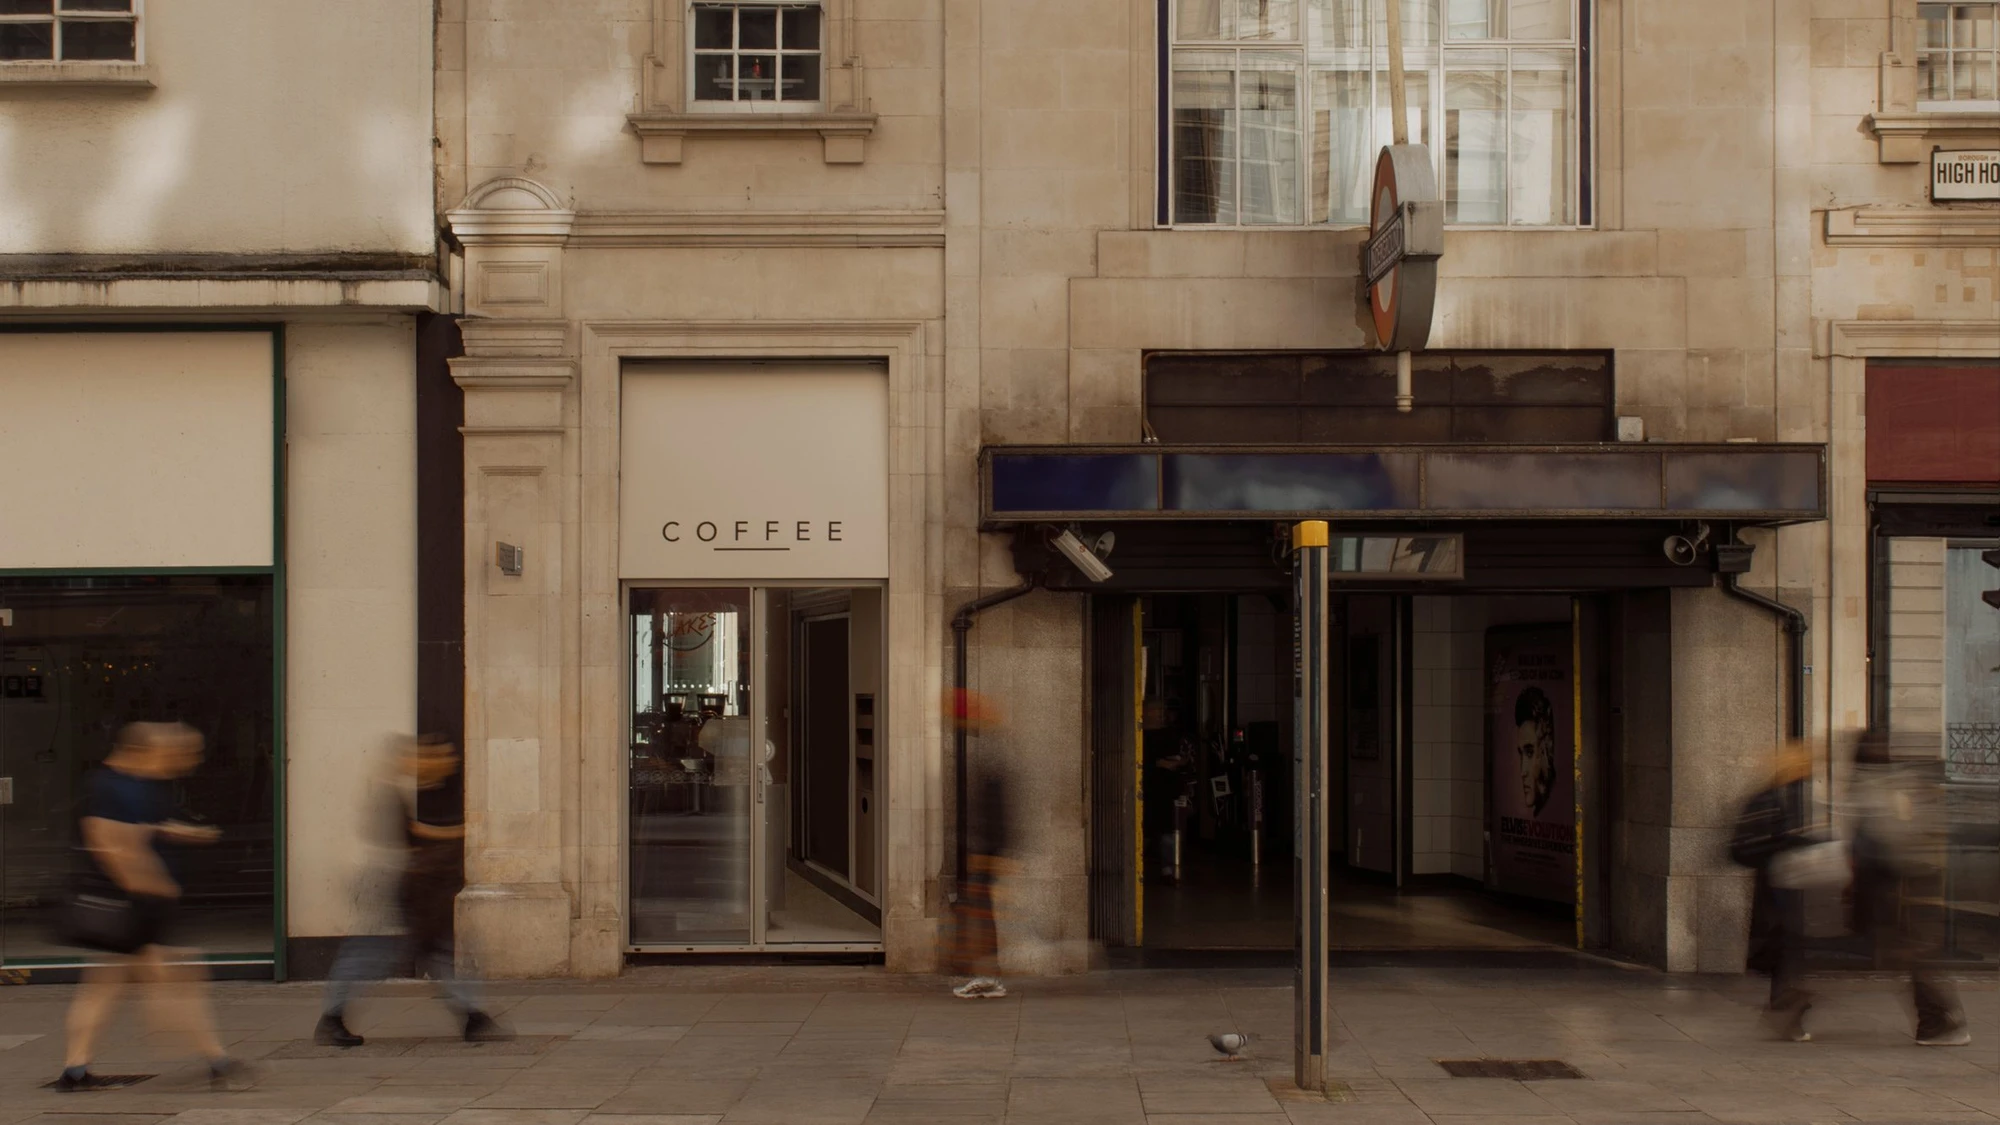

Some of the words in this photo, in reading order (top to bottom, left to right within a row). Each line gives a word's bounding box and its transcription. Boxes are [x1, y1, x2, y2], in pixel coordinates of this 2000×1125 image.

[1937, 162, 1974, 184] HIGH
[1979, 162, 2000, 184] HO
[662, 521, 842, 542] COFFEE
